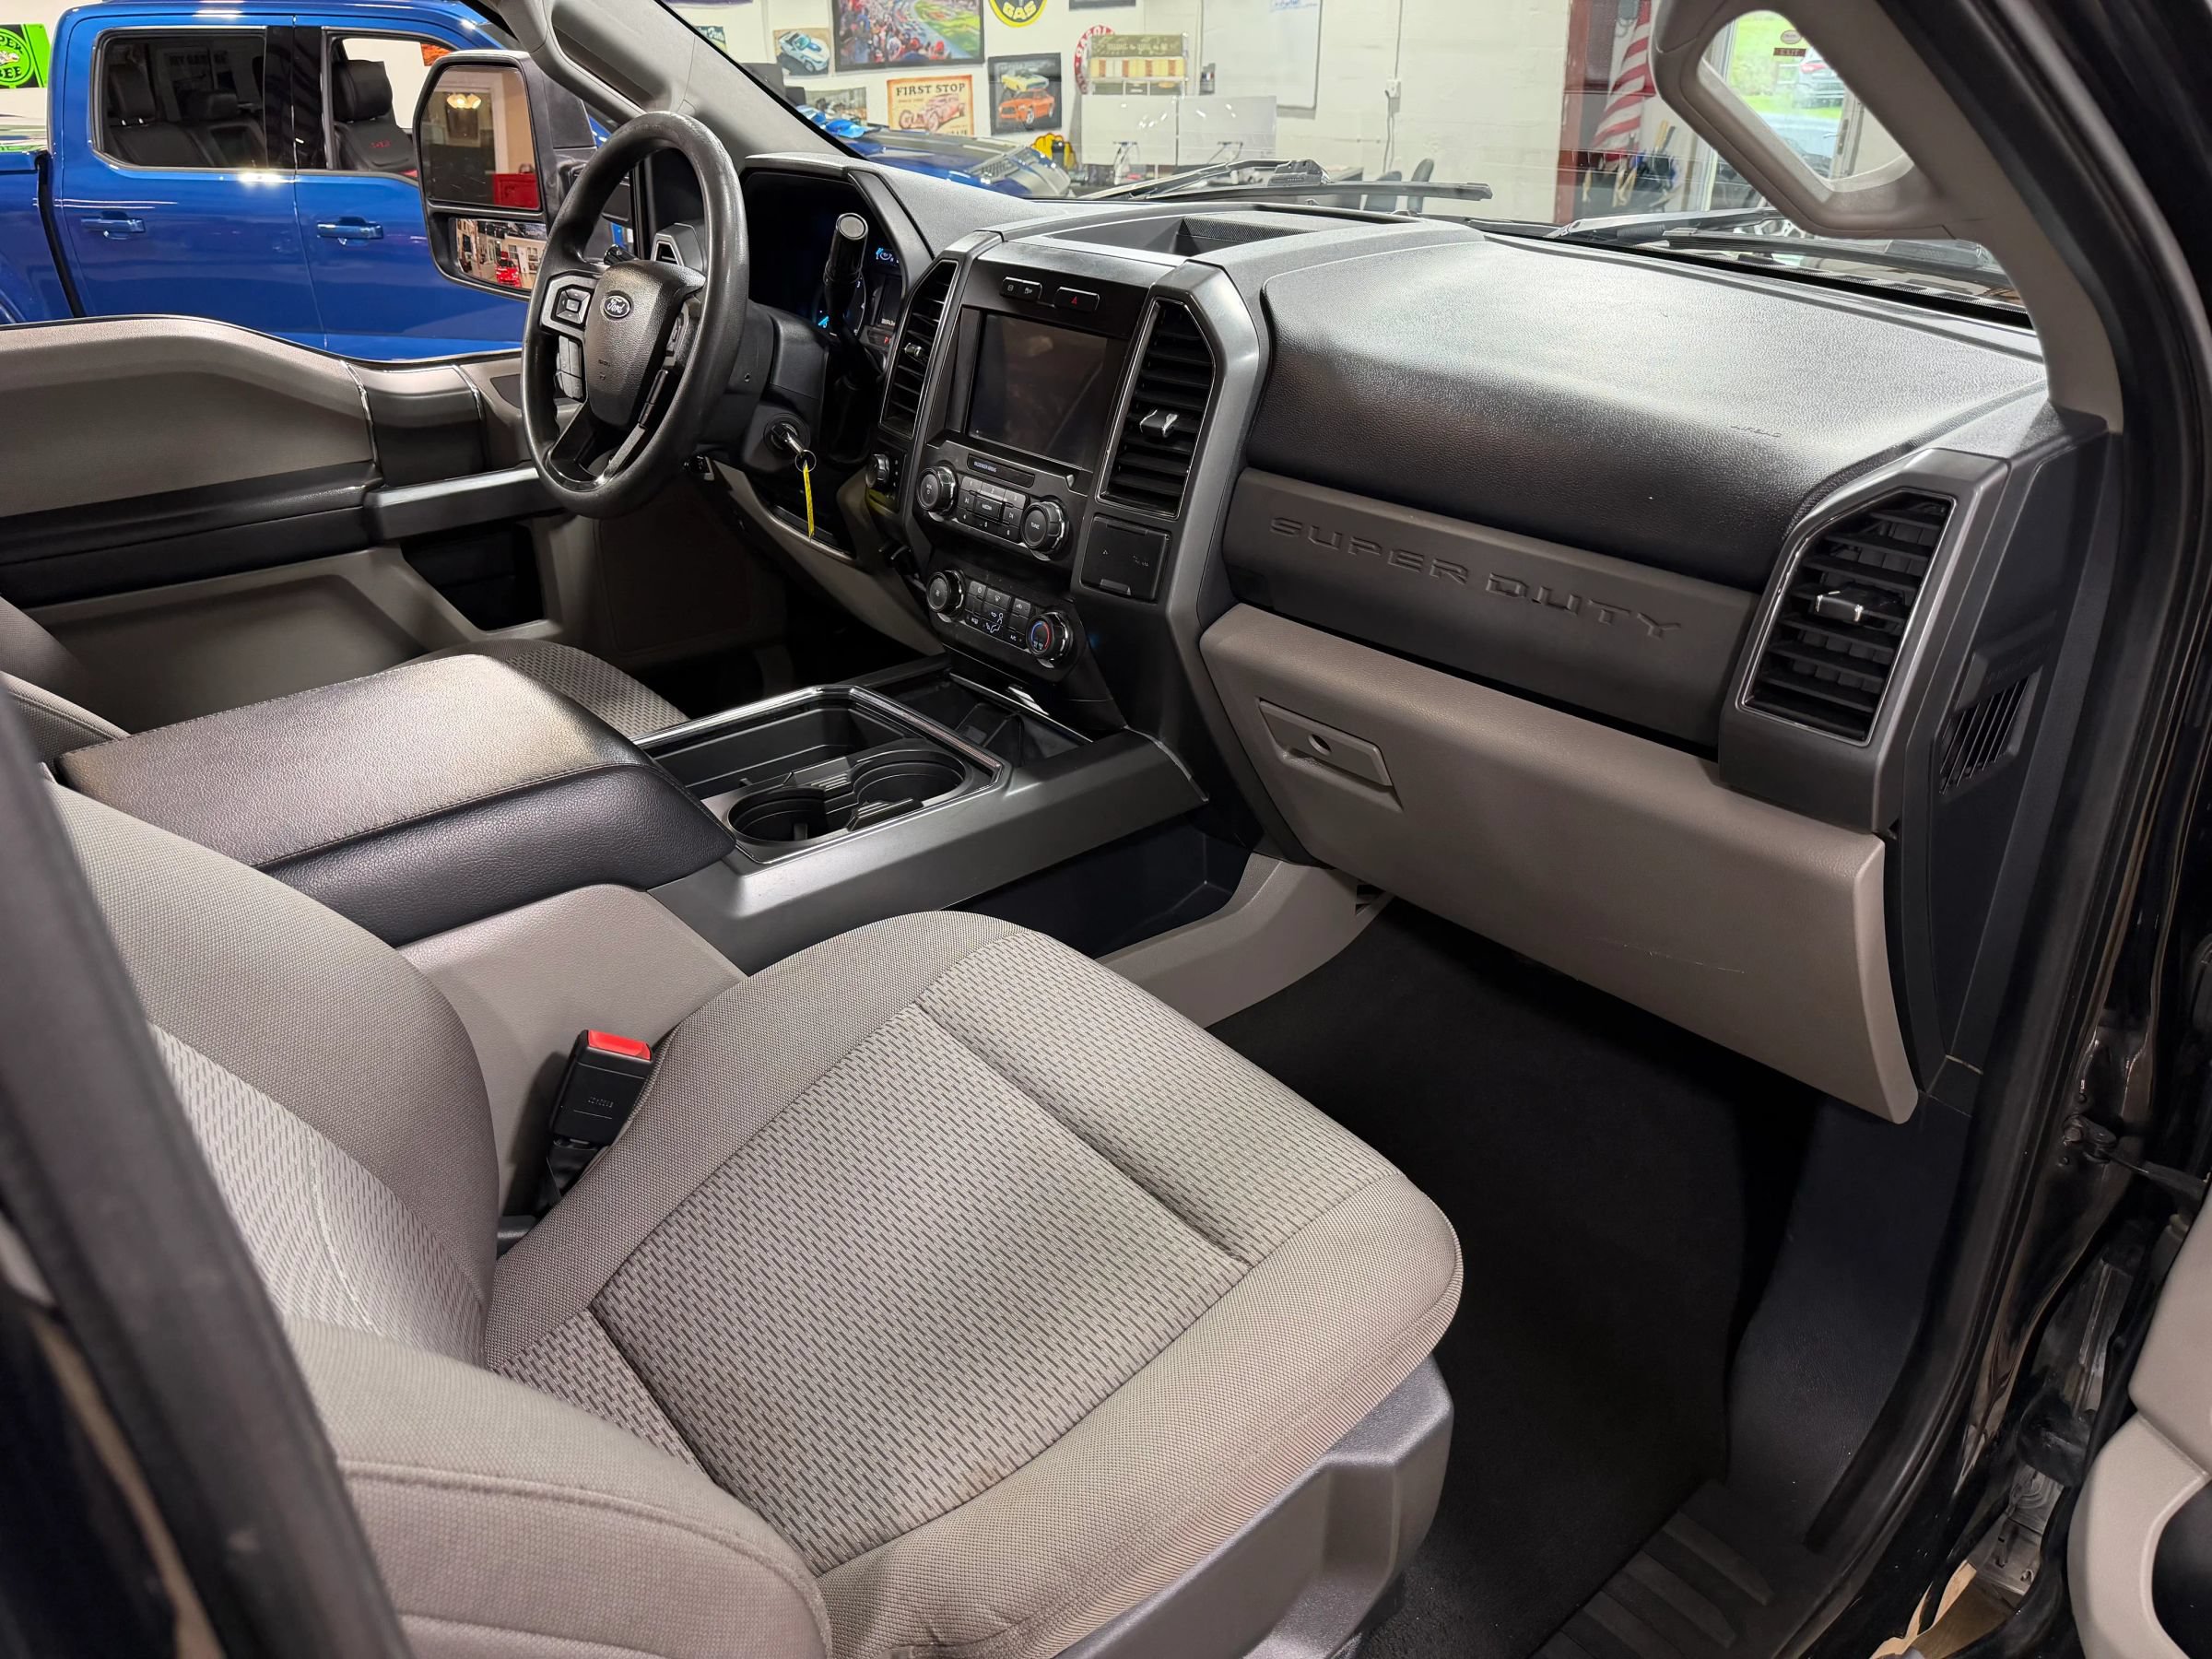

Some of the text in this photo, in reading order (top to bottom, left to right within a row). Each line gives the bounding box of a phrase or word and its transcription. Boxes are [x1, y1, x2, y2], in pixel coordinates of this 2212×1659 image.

[1002, 1, 1037, 20] GAS
[896, 83, 965, 96] FIRST STOP
[606, 297, 626, 314] Ford
[1270, 517, 1682, 639] SUPER DUTY
